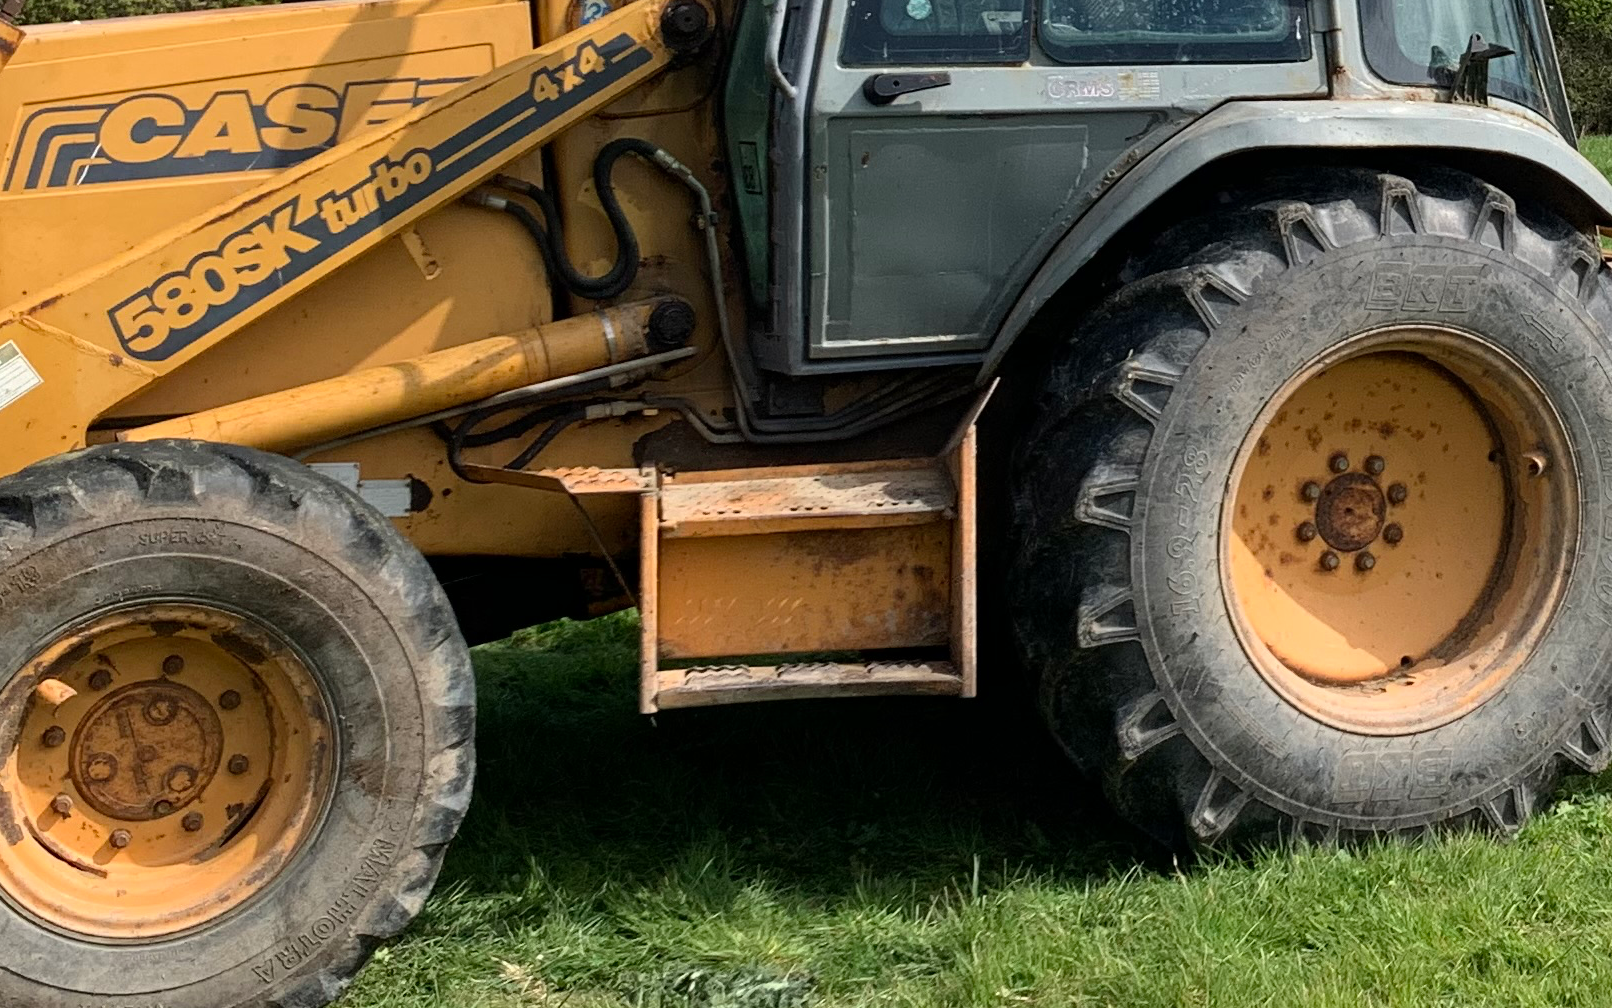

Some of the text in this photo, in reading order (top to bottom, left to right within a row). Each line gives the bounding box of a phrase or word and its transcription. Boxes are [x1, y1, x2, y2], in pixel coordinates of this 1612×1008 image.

[110, 44, 607, 353] 580SK turbo 4x4
[1364, 260, 1484, 313] BKT
[137, 529, 190, 547] SUPER
[1165, 445, 1211, 617] 16.9-28
[1331, 748, 1454, 804] BKT
[252, 837, 397, 984] MALHOTRA
